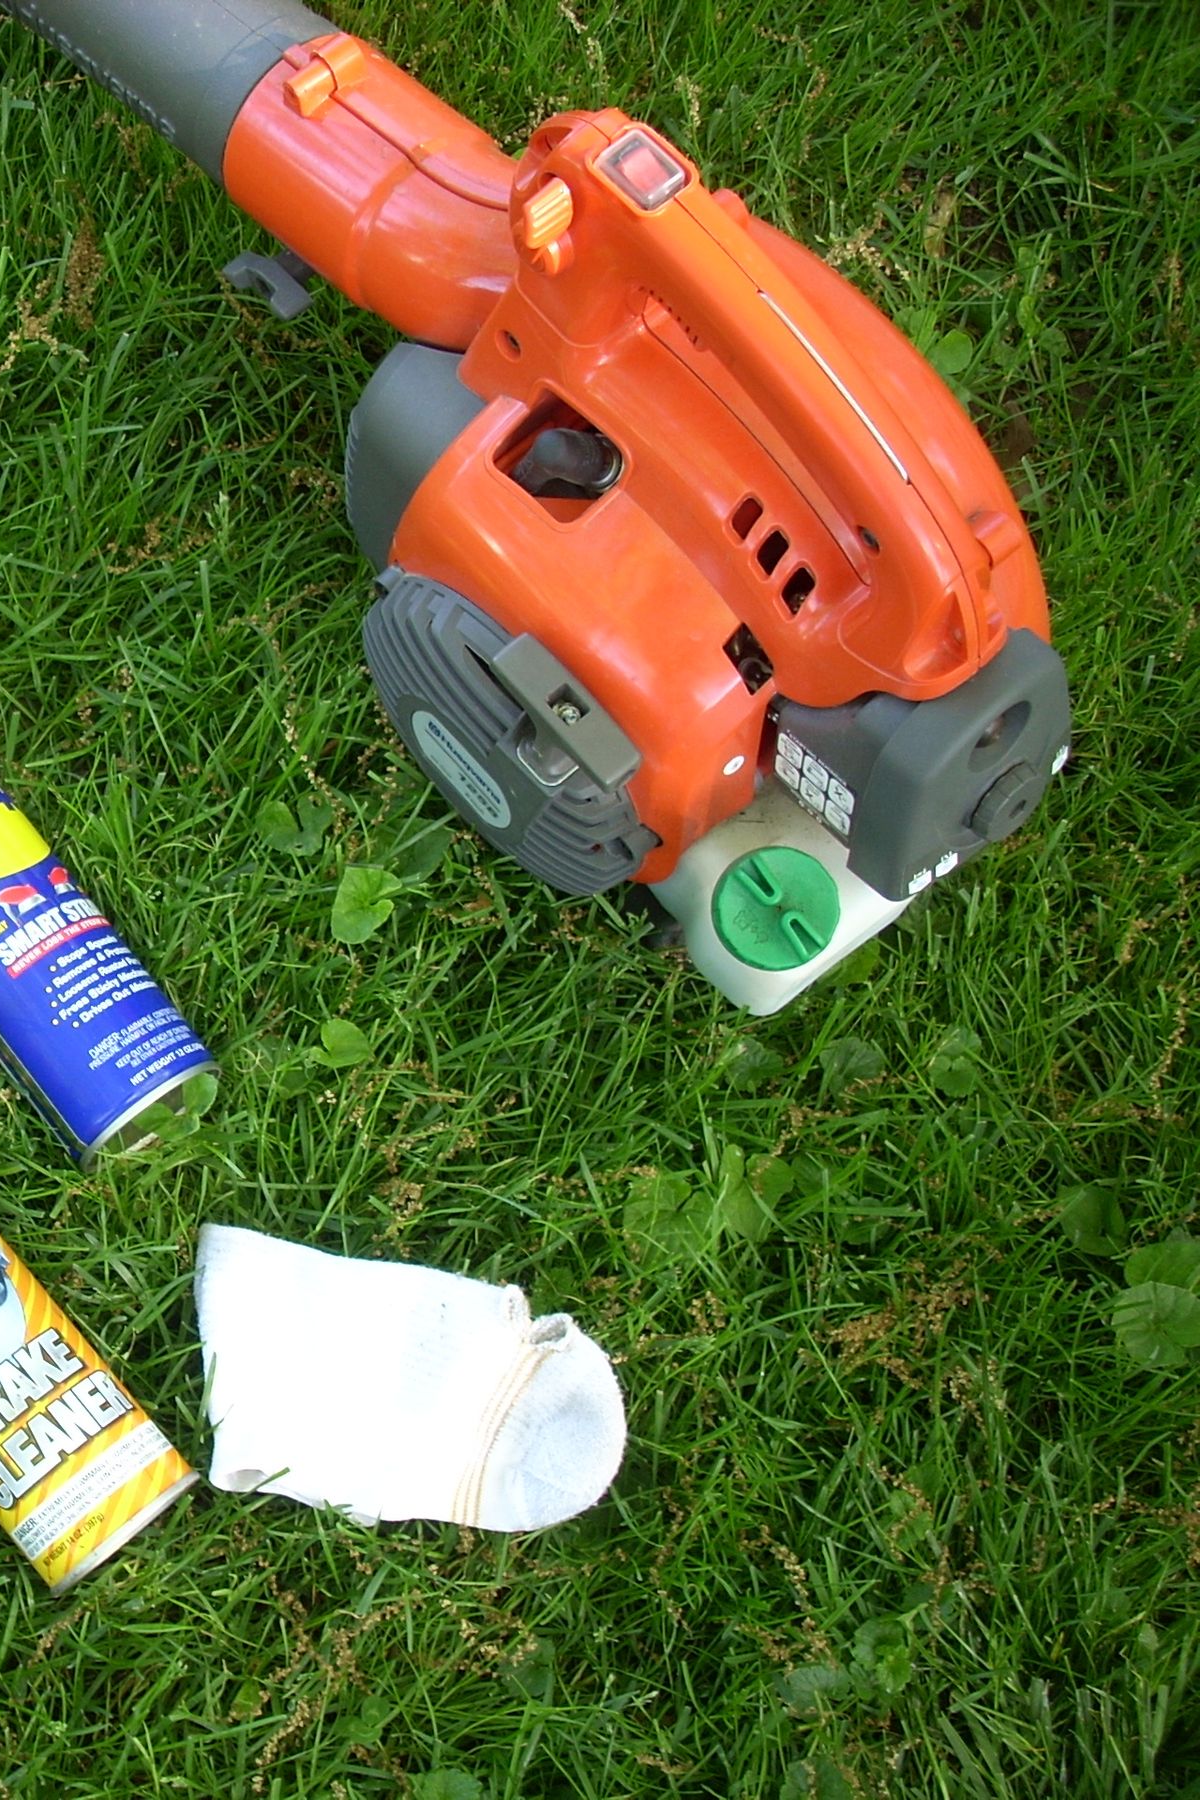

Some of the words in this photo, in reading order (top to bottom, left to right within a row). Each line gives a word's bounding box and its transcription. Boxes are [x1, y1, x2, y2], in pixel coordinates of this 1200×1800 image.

[60, 897, 104, 923] STRA
[11, 948, 42, 974] NEVER
[43, 934, 65, 951] LOSE
[65, 925, 81, 937] THE
[57, 946, 87, 968] Stops
[52, 957, 97, 988] Removes
[58, 972, 100, 1003] Loosens
[98, 959, 129, 981] Rusted
[59, 997, 90, 1021] Frees
[88, 978, 120, 999] Sticky
[79, 1000, 113, 1023] Drives
[112, 988, 131, 1002] Out
[88, 1031, 122, 1059] DANGER:
[115, 1054, 132, 1069] KEEP
[129, 1068, 148, 1086] NET
[146, 1051, 177, 1074] WEIGHT
[175, 1048, 186, 1058] 12
